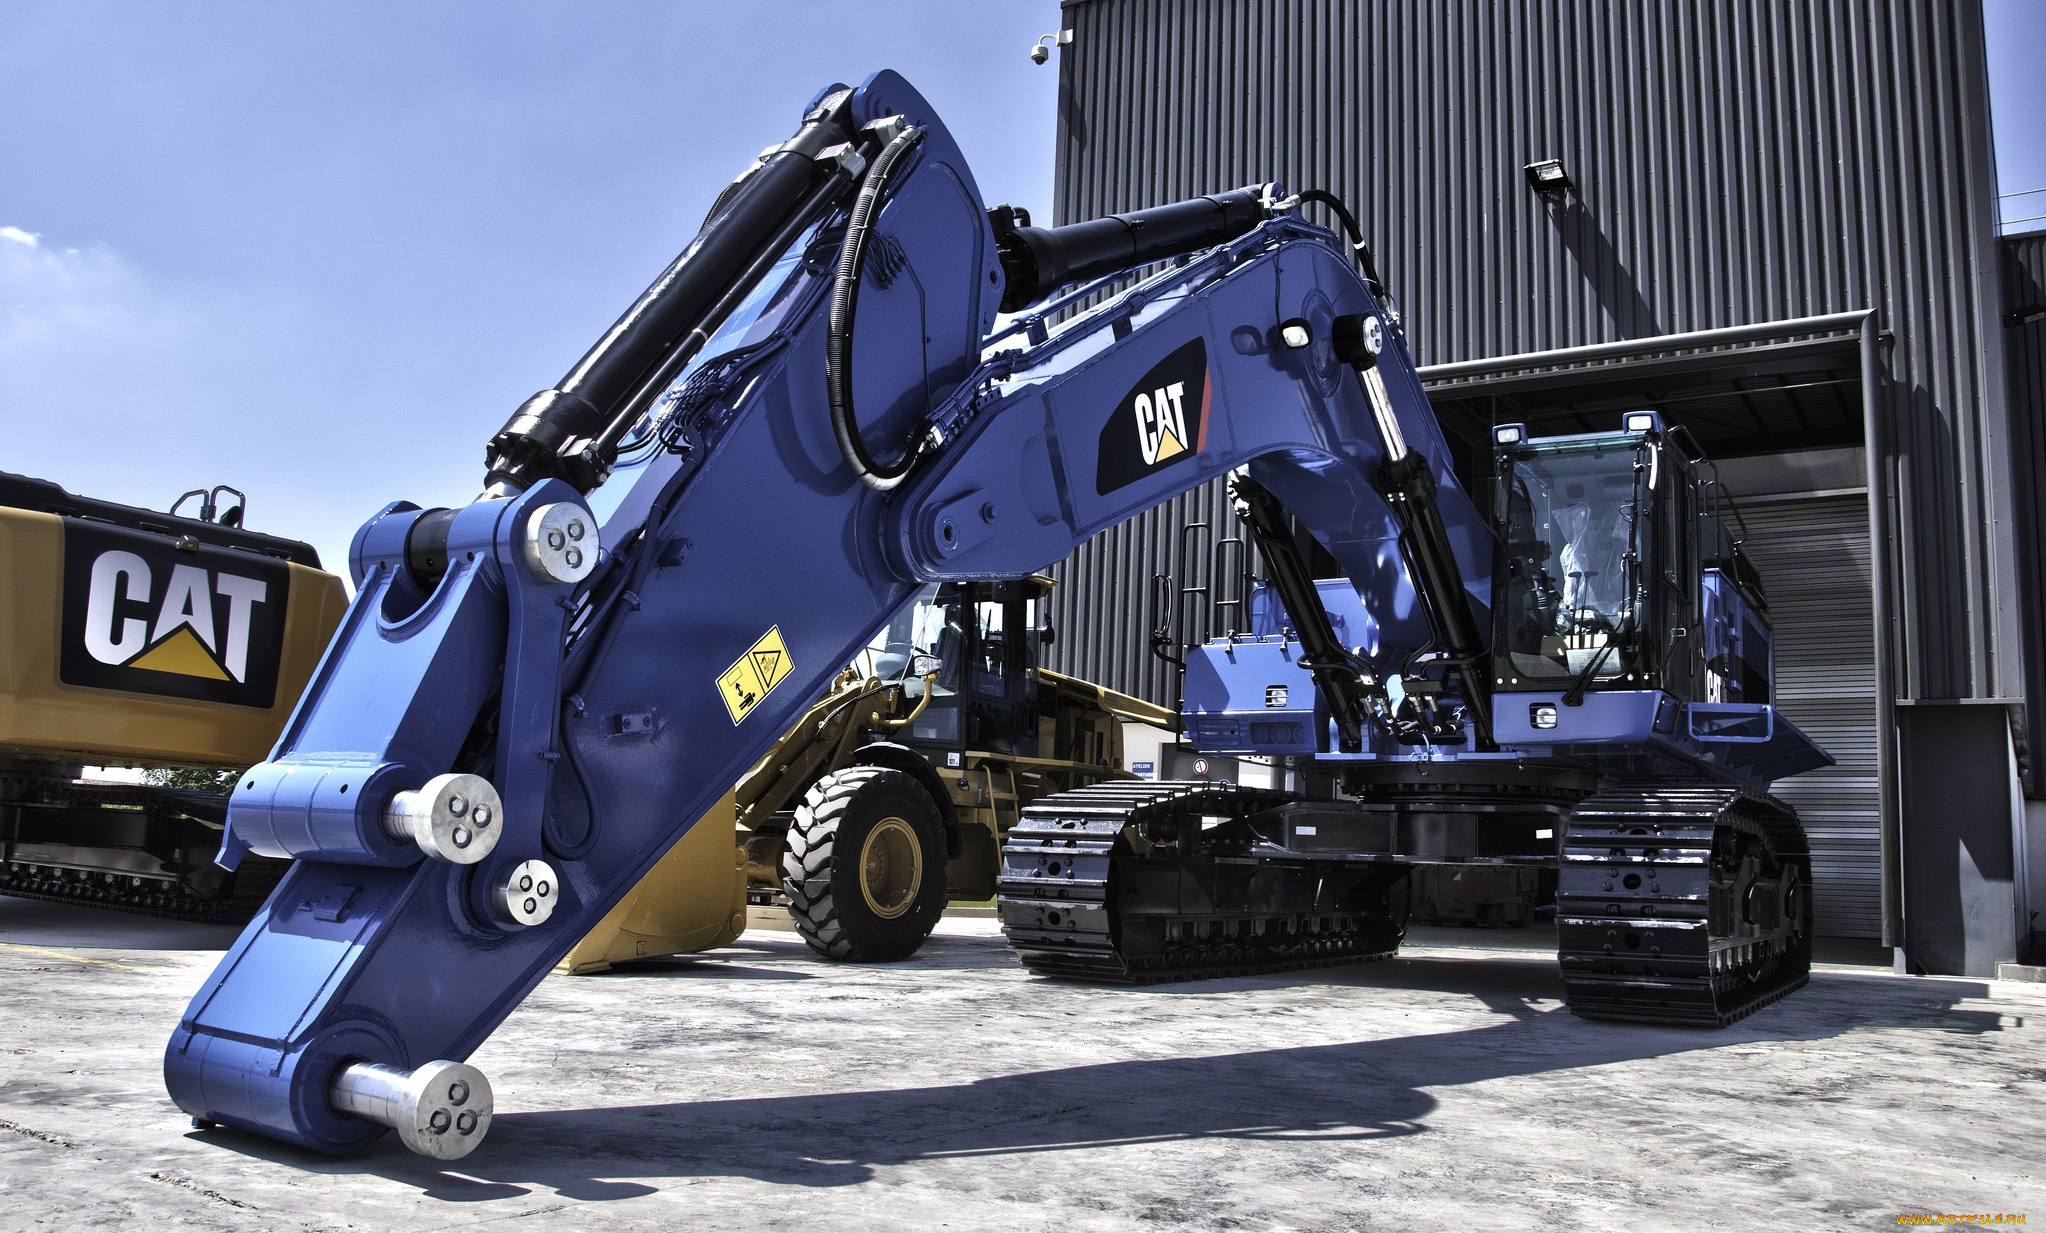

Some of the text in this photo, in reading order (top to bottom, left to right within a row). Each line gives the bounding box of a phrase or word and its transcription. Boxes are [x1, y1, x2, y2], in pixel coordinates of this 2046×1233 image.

[1134, 381, 1189, 466] CAT
[84, 550, 267, 684] CAT
[1706, 669, 1722, 704] CAT
